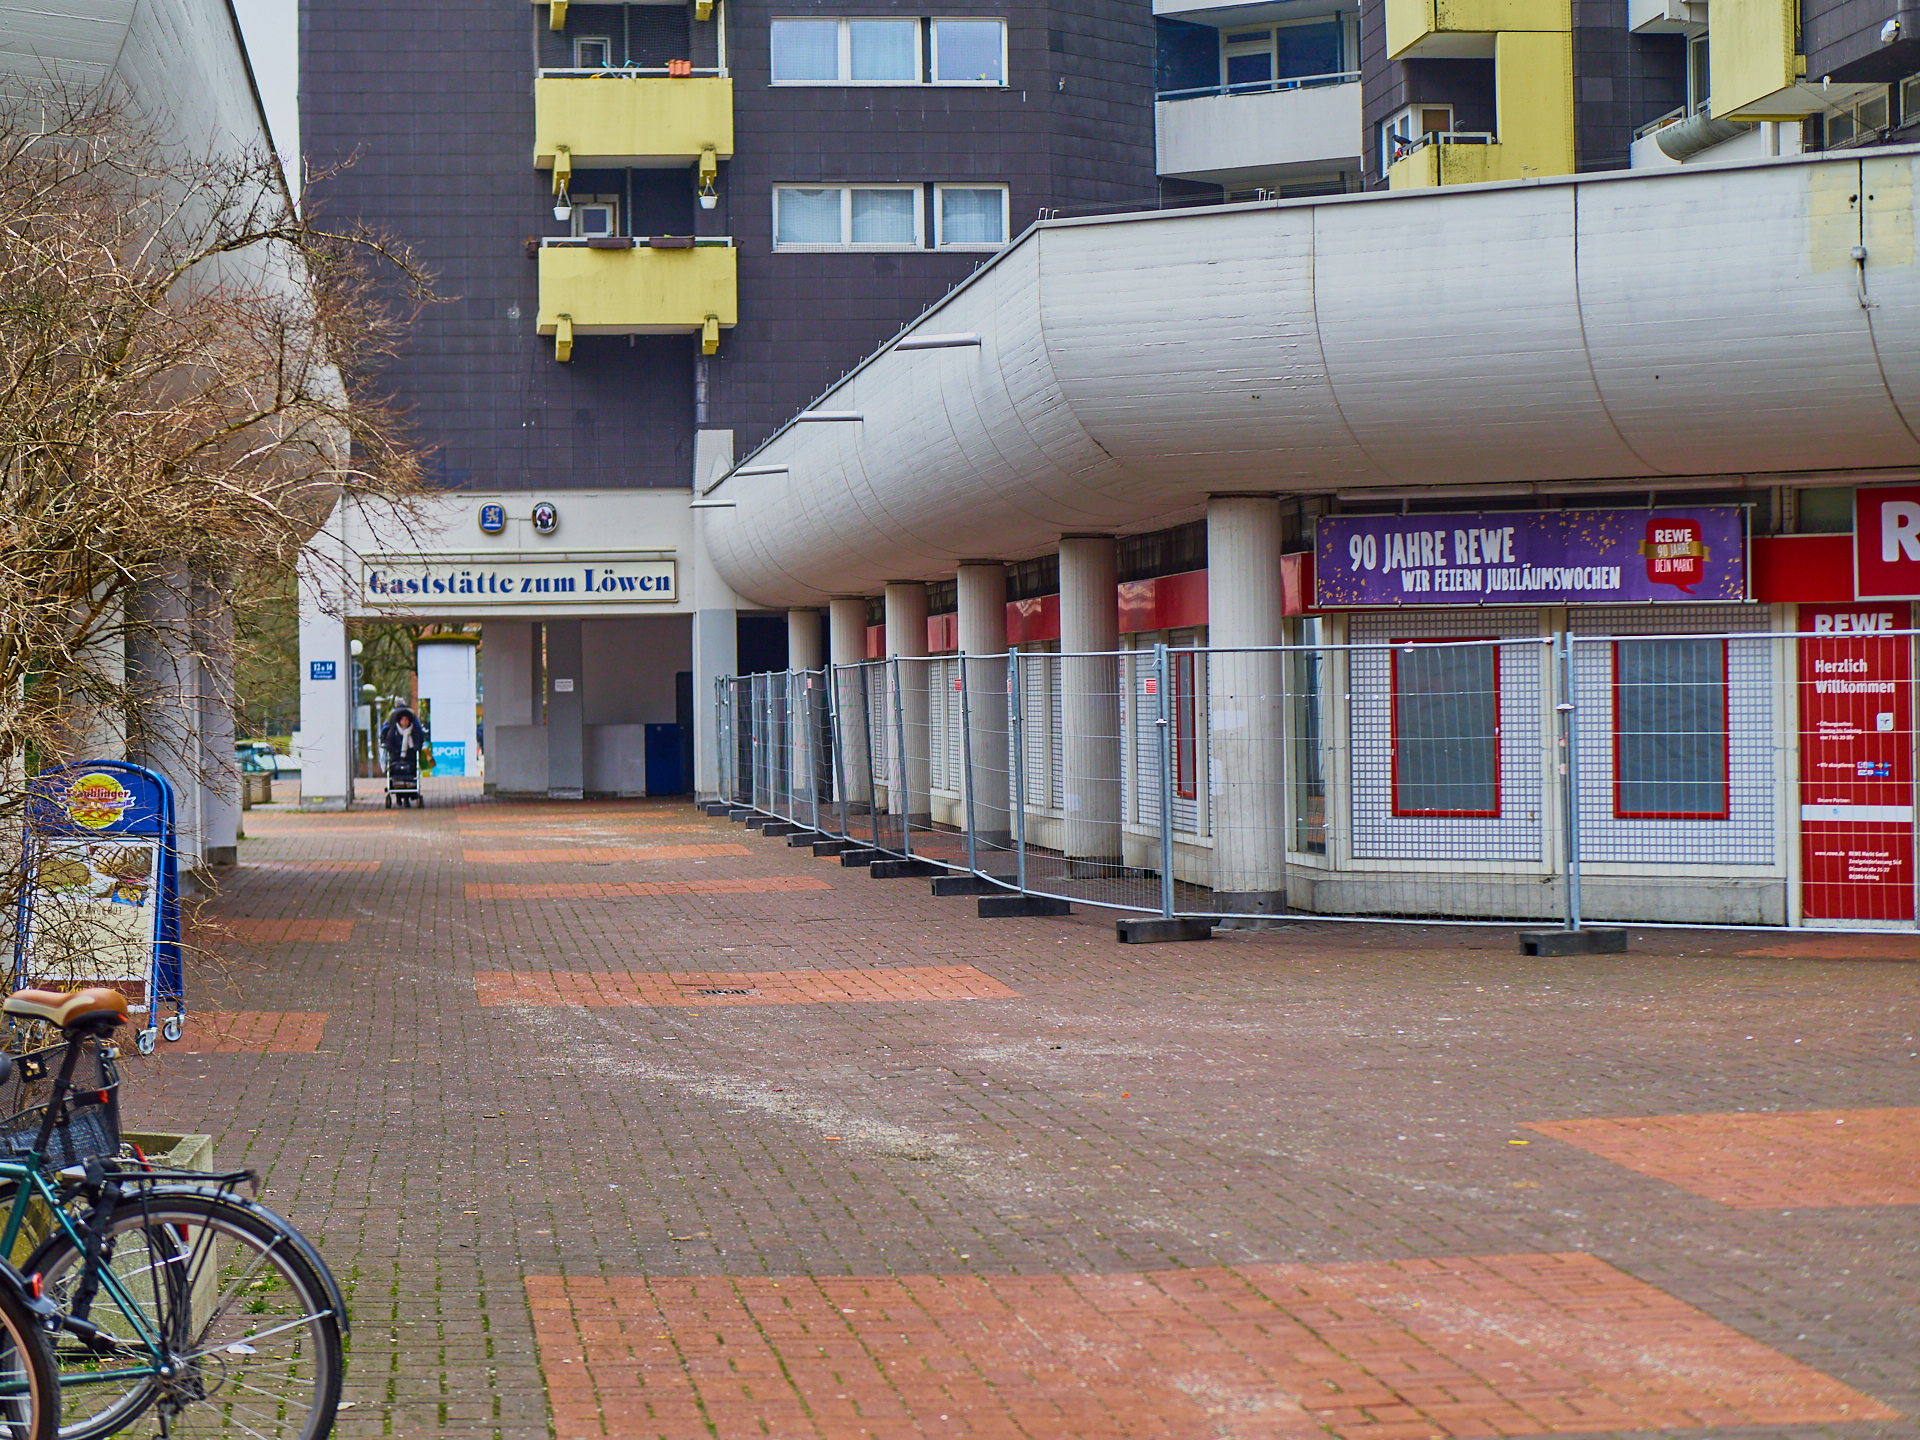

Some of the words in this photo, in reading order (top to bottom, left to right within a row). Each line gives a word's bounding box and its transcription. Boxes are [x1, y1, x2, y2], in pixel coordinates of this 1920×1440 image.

[1655, 529, 1692, 542] REWE
[1349, 534, 1376, 571] 90
[1383, 531, 1446, 574] JAHRE
[1454, 527, 1515, 566] REWE
[1657, 544, 1668, 557] 90
[1670, 542, 1690, 557] JAHRE
[1655, 559, 1671, 572] DEIN
[1673, 559, 1693, 572] MARKT
[369, 570, 513, 594] Gaststätte
[519, 577, 575, 593] zum
[583, 568, 671, 592] Löwen
[1401, 569, 1430, 592] WIR
[1434, 568, 1482, 592] FEIERN
[1485, 562, 1620, 594] JUBILÄUMSWOCHEN
[1815, 613, 1894, 639] REWE
[1815, 658, 1868, 673] Herzlich
[1815, 679, 1896, 694] Willkommen
[433, 746, 465, 757] SPORT
